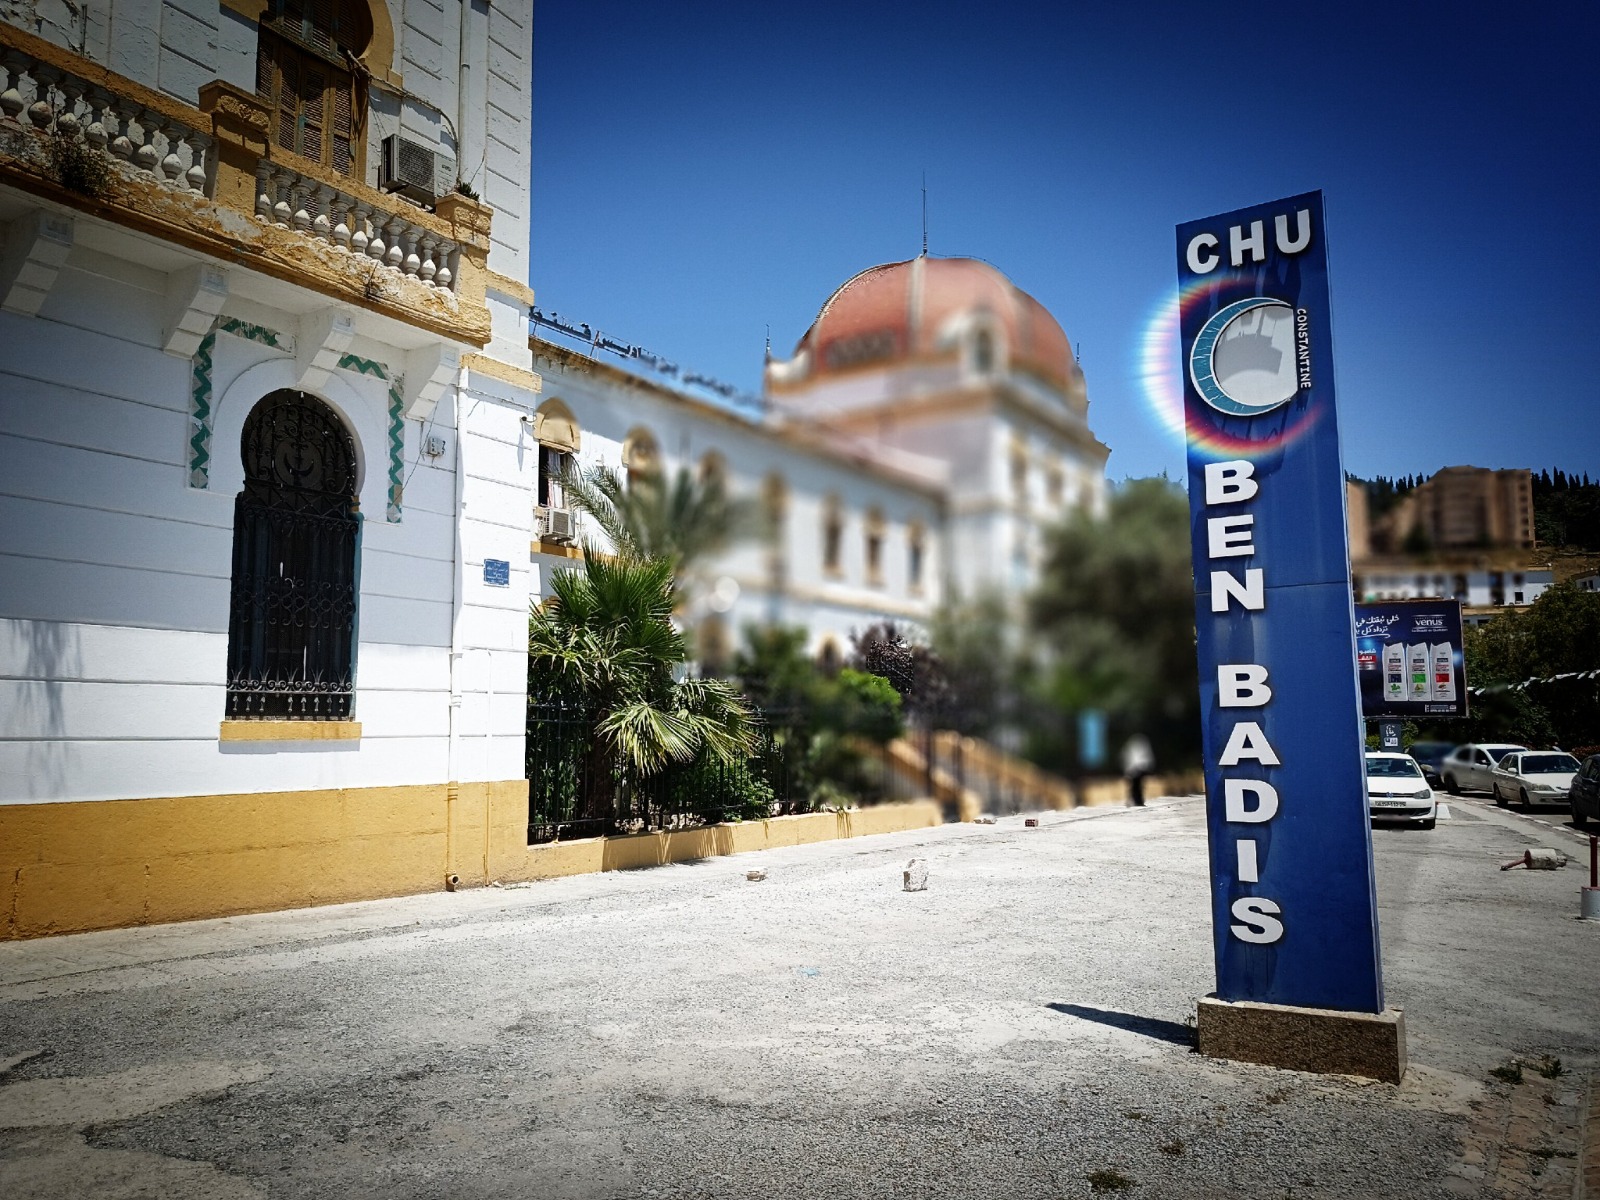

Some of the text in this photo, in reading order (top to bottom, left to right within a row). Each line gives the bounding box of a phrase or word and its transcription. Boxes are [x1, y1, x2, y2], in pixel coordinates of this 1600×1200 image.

[1187, 209, 1310, 274] CHU
[1296, 308, 1312, 389] CONSTANTINE
[1204, 460, 1284, 945] BEN BADIS
